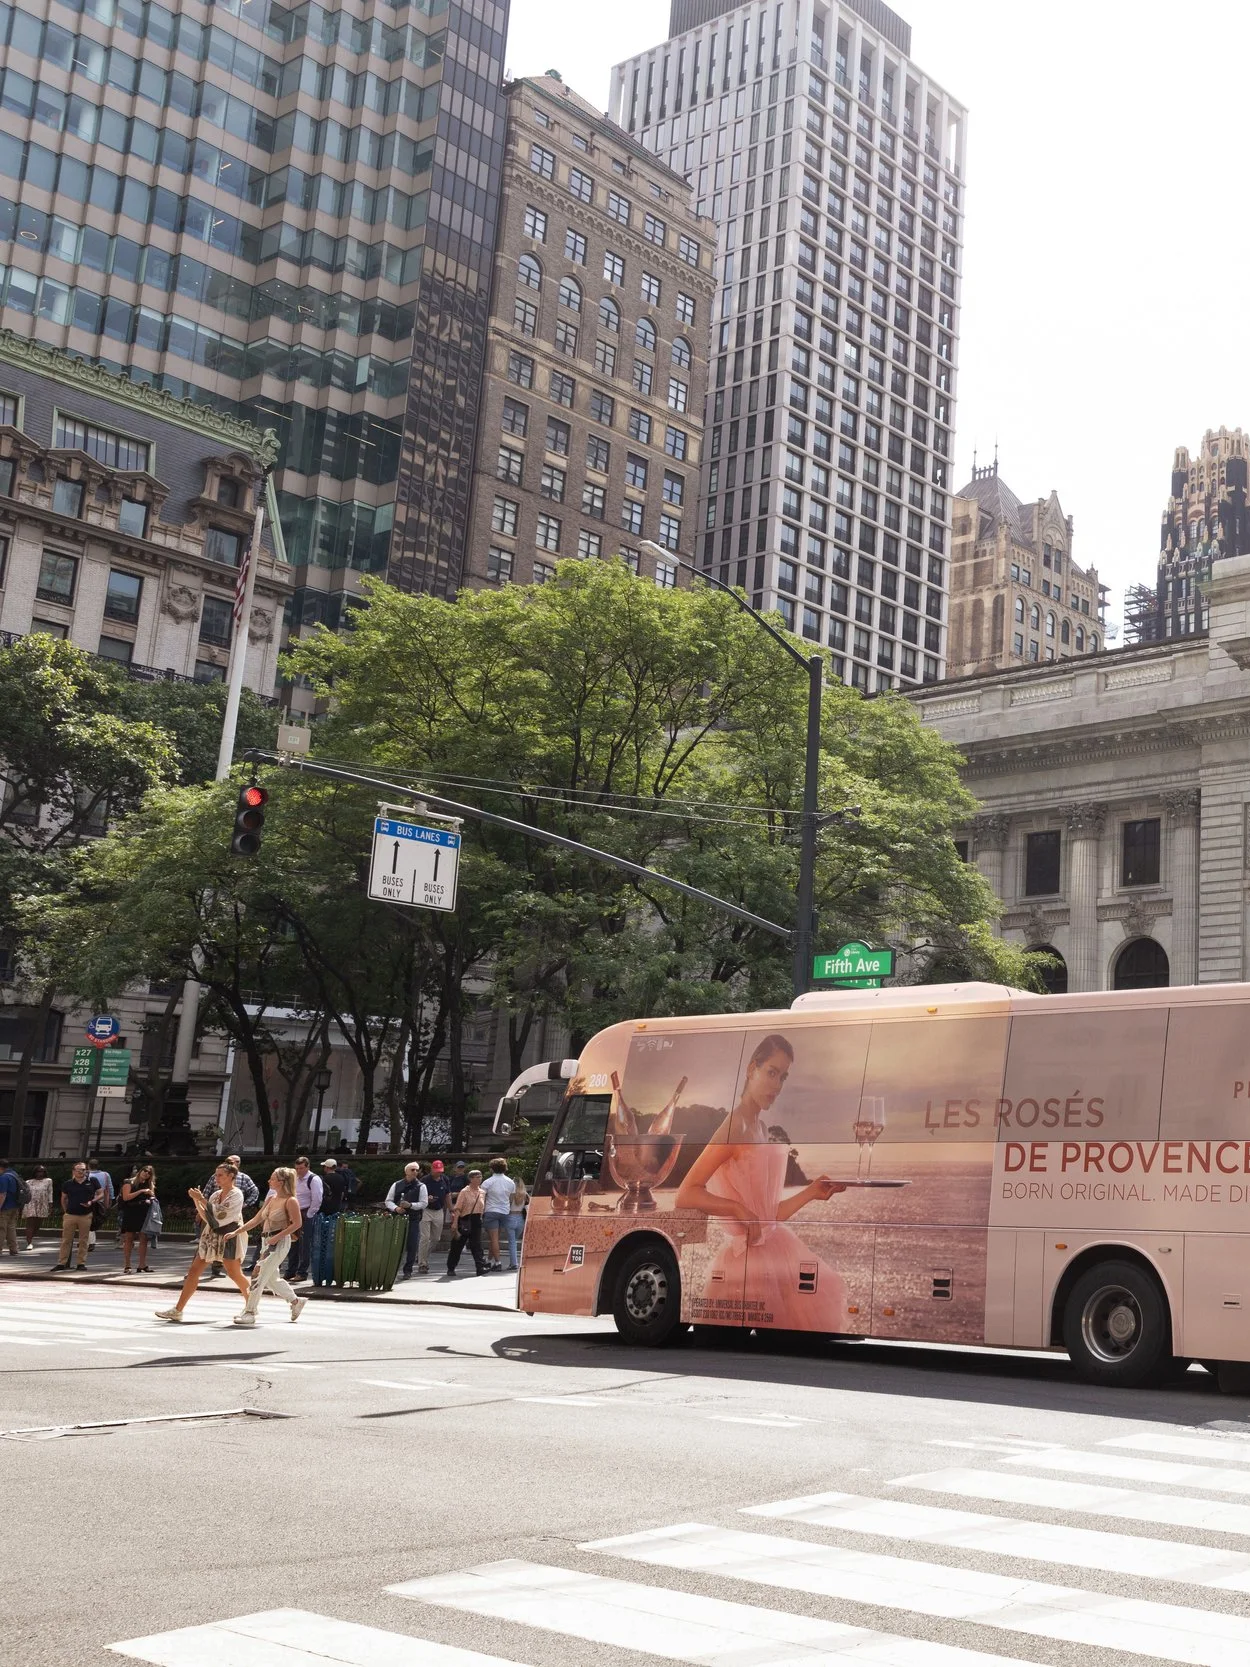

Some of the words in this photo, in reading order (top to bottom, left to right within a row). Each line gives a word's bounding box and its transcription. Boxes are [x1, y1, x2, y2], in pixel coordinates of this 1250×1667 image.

[396, 825, 412, 837] BUS
[415, 830, 441, 842] LANES
[382, 875, 404, 888] BUSES
[424, 883, 444, 894] BUSES
[382, 887, 402, 898] ONLY
[424, 894, 442, 905] ONLY
[824, 958, 852, 975] Fifth
[856, 958, 880, 973] Ave
[590, 1074, 608, 1088] 280
[924, 1099, 982, 1129] LES
[994, 1090, 1104, 1128] ROSÉS
[1004, 1142, 1048, 1173] DE
[1002, 1182, 1054, 1200] BORN
[1060, 1182, 1156, 1202] ORIGINAL.
[1164, 1184, 1222, 1203] MADE
